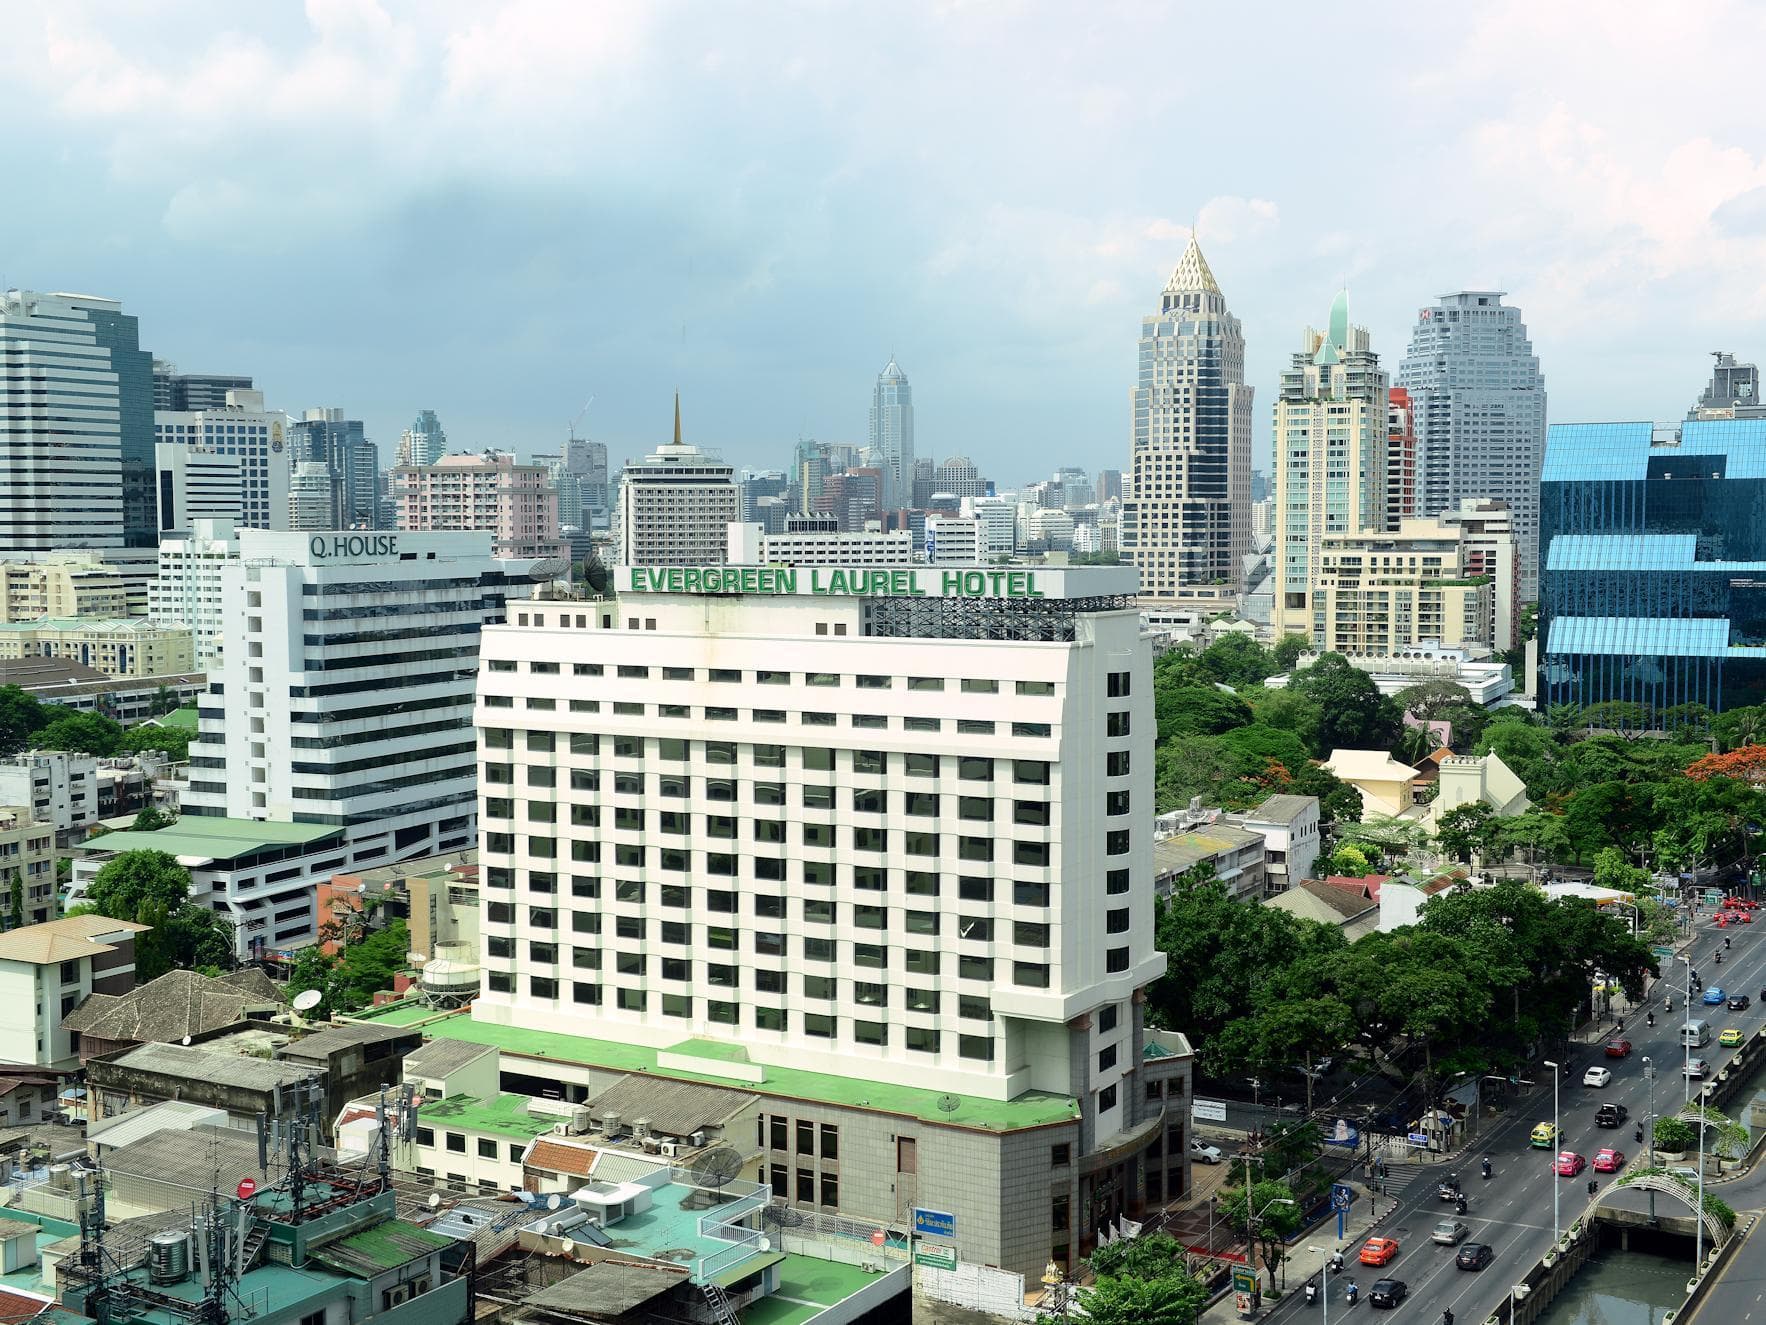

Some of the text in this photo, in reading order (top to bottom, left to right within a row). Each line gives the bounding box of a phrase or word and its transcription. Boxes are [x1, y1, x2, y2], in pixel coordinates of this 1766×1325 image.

[311, 536, 398, 558] Q.HOUSE
[631, 567, 1044, 598] EVERGREEN LAUREL HOTEL
